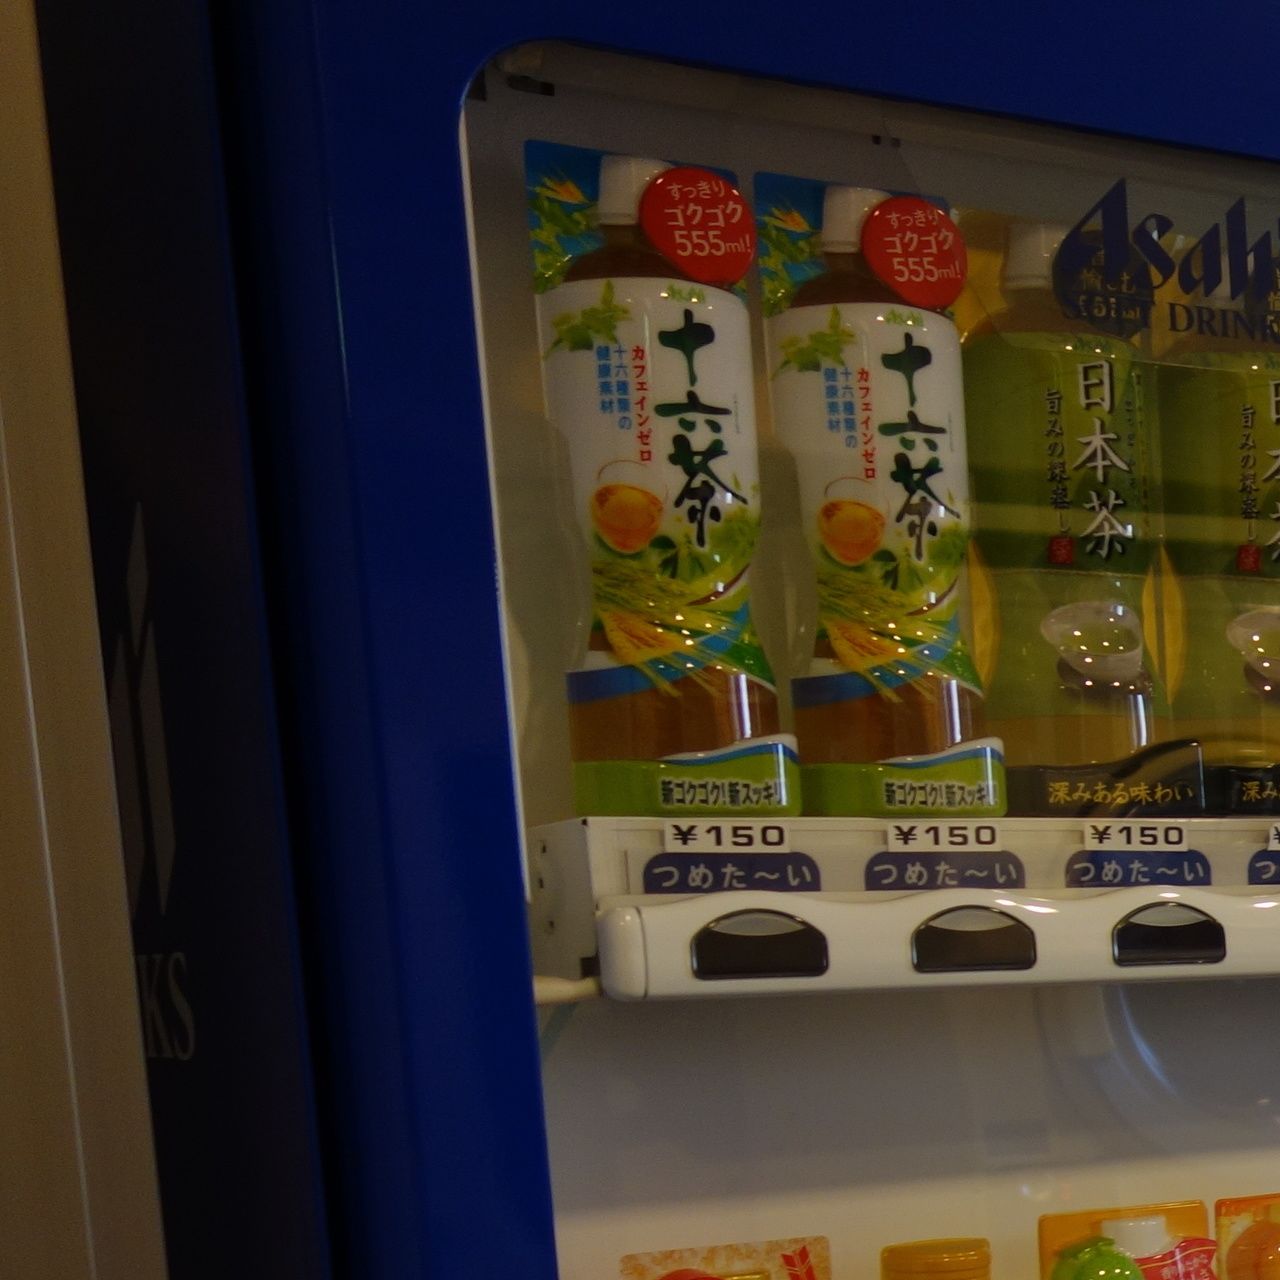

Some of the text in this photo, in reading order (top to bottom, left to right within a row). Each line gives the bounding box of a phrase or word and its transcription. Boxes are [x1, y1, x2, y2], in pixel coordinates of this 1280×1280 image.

[667, 180, 726, 198] すっきり
[664, 204, 743, 228] ゴクゴク
[887, 210, 941, 228] すっきり
[675, 230, 751, 257] 555ml!
[885, 229, 954, 253] ゴクゴク
[893, 258, 961, 282] 555ml!
[631, 345, 652, 463] カフェインゼロ
[655, 309, 747, 548] 十六茶
[857, 368, 876, 480] カフェインゼロ
[878, 333, 960, 561] 十六茶
[1073, 359, 1131, 559] 日本茶
[1048, 781, 1194, 805] 深みある味わい
[672, 825, 785, 847] ¥150
[895, 825, 996, 846] ¥150
[1090, 825, 1184, 846] ¥150
